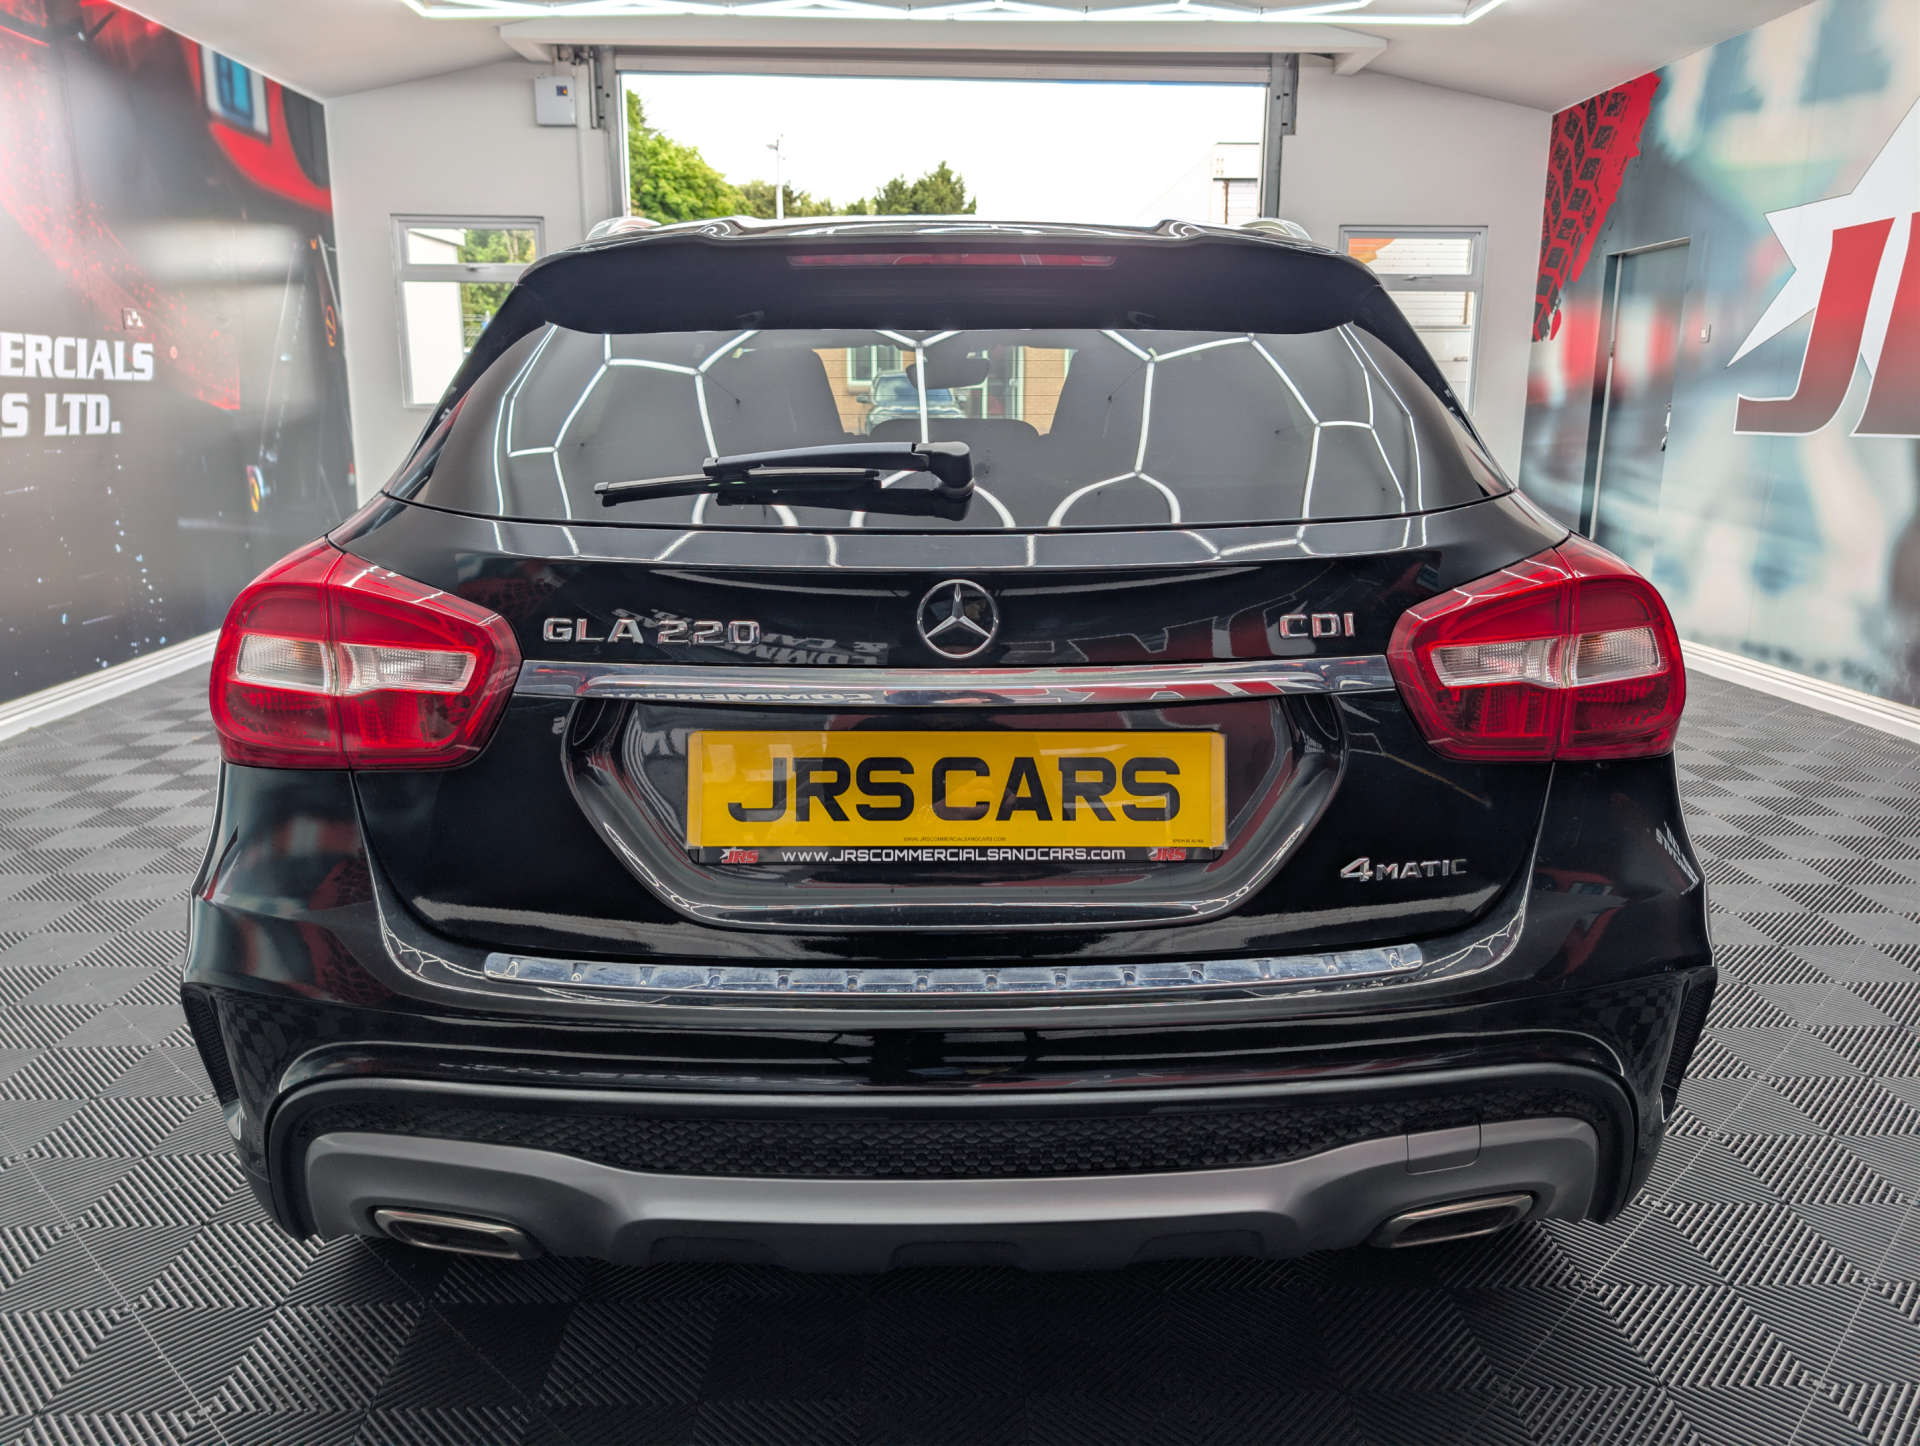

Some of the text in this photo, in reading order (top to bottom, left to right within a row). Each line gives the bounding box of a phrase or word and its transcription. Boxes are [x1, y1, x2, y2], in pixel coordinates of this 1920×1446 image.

[44, 392, 121, 436] LTD.
[543, 617, 761, 645] GLA 220
[1279, 612, 1355, 638] CDI
[727, 756, 1181, 823] JRS CARS
[721, 848, 760, 864] JRS
[1340, 856, 1468, 882] 4MATIC
